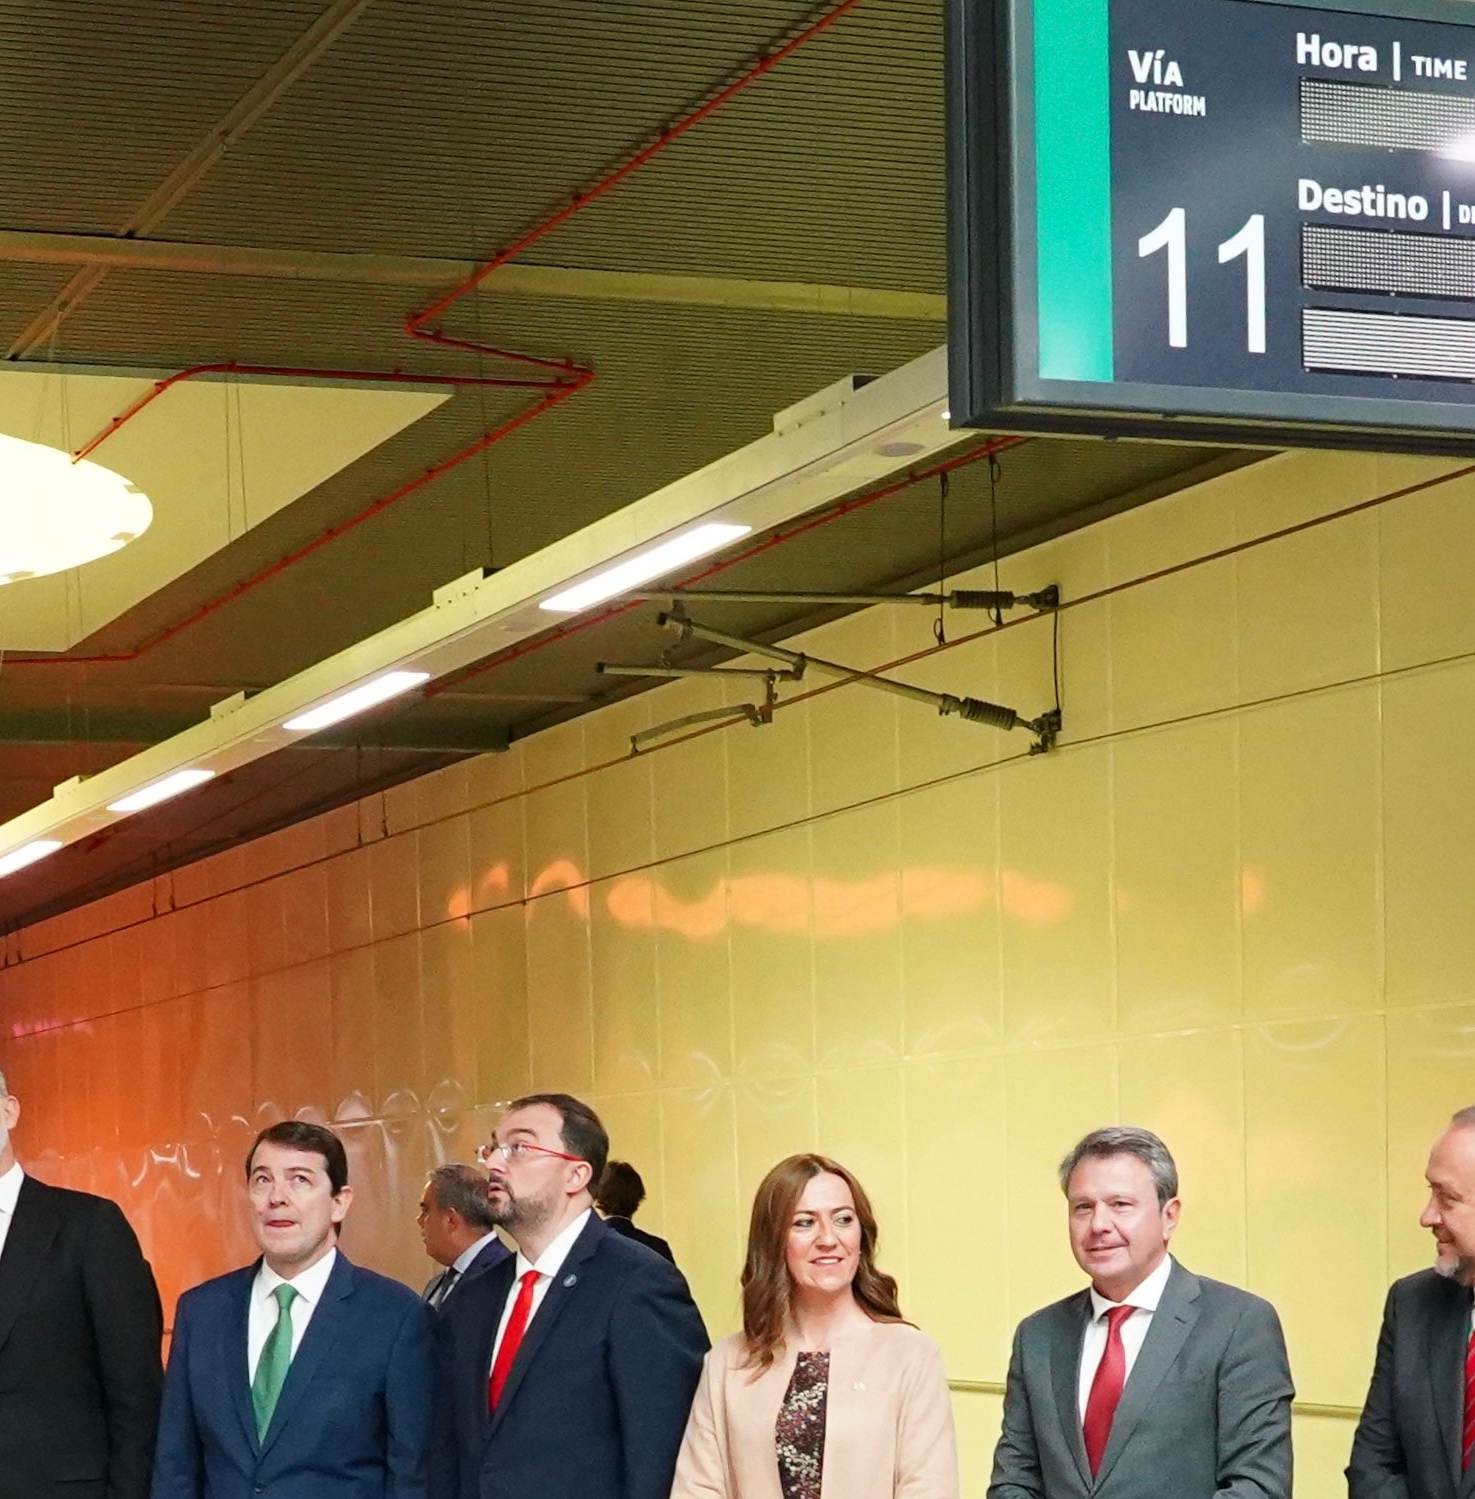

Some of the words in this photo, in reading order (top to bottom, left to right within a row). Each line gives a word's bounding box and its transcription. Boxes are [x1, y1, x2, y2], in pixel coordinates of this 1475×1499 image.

[1296, 32, 1378, 72] Hora
[1411, 55, 1468, 81] TIME
[1129, 89, 1207, 116] PLATFORM
[1297, 178, 1429, 221] Destino
[1138, 206, 1267, 354] 11
